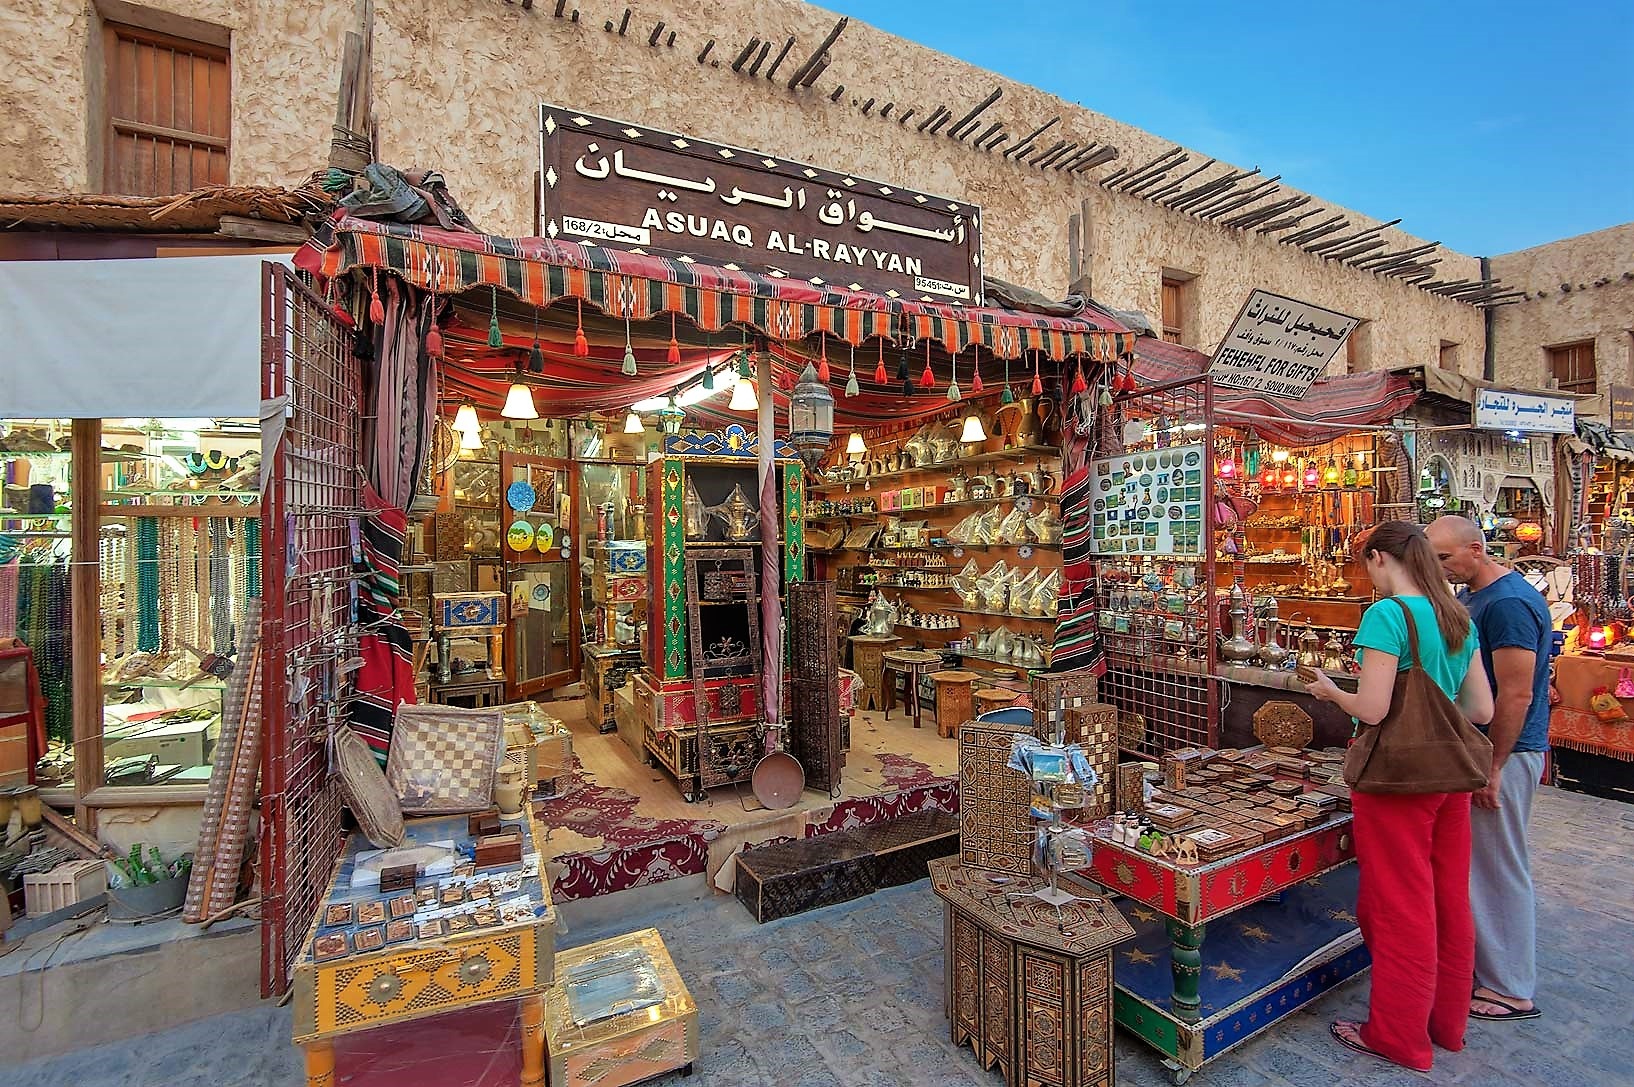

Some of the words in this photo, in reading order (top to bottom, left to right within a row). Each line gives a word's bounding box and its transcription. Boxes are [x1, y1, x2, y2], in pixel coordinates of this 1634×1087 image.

[574, 142, 807, 211] الريان
[640, 207, 754, 247] ASUAQ
[765, 231, 924, 275] AL-RAYYAN
[817, 188, 966, 246] أسواق
[1264, 357, 1289, 377] FOR
[1286, 362, 1320, 382] GIFTS
